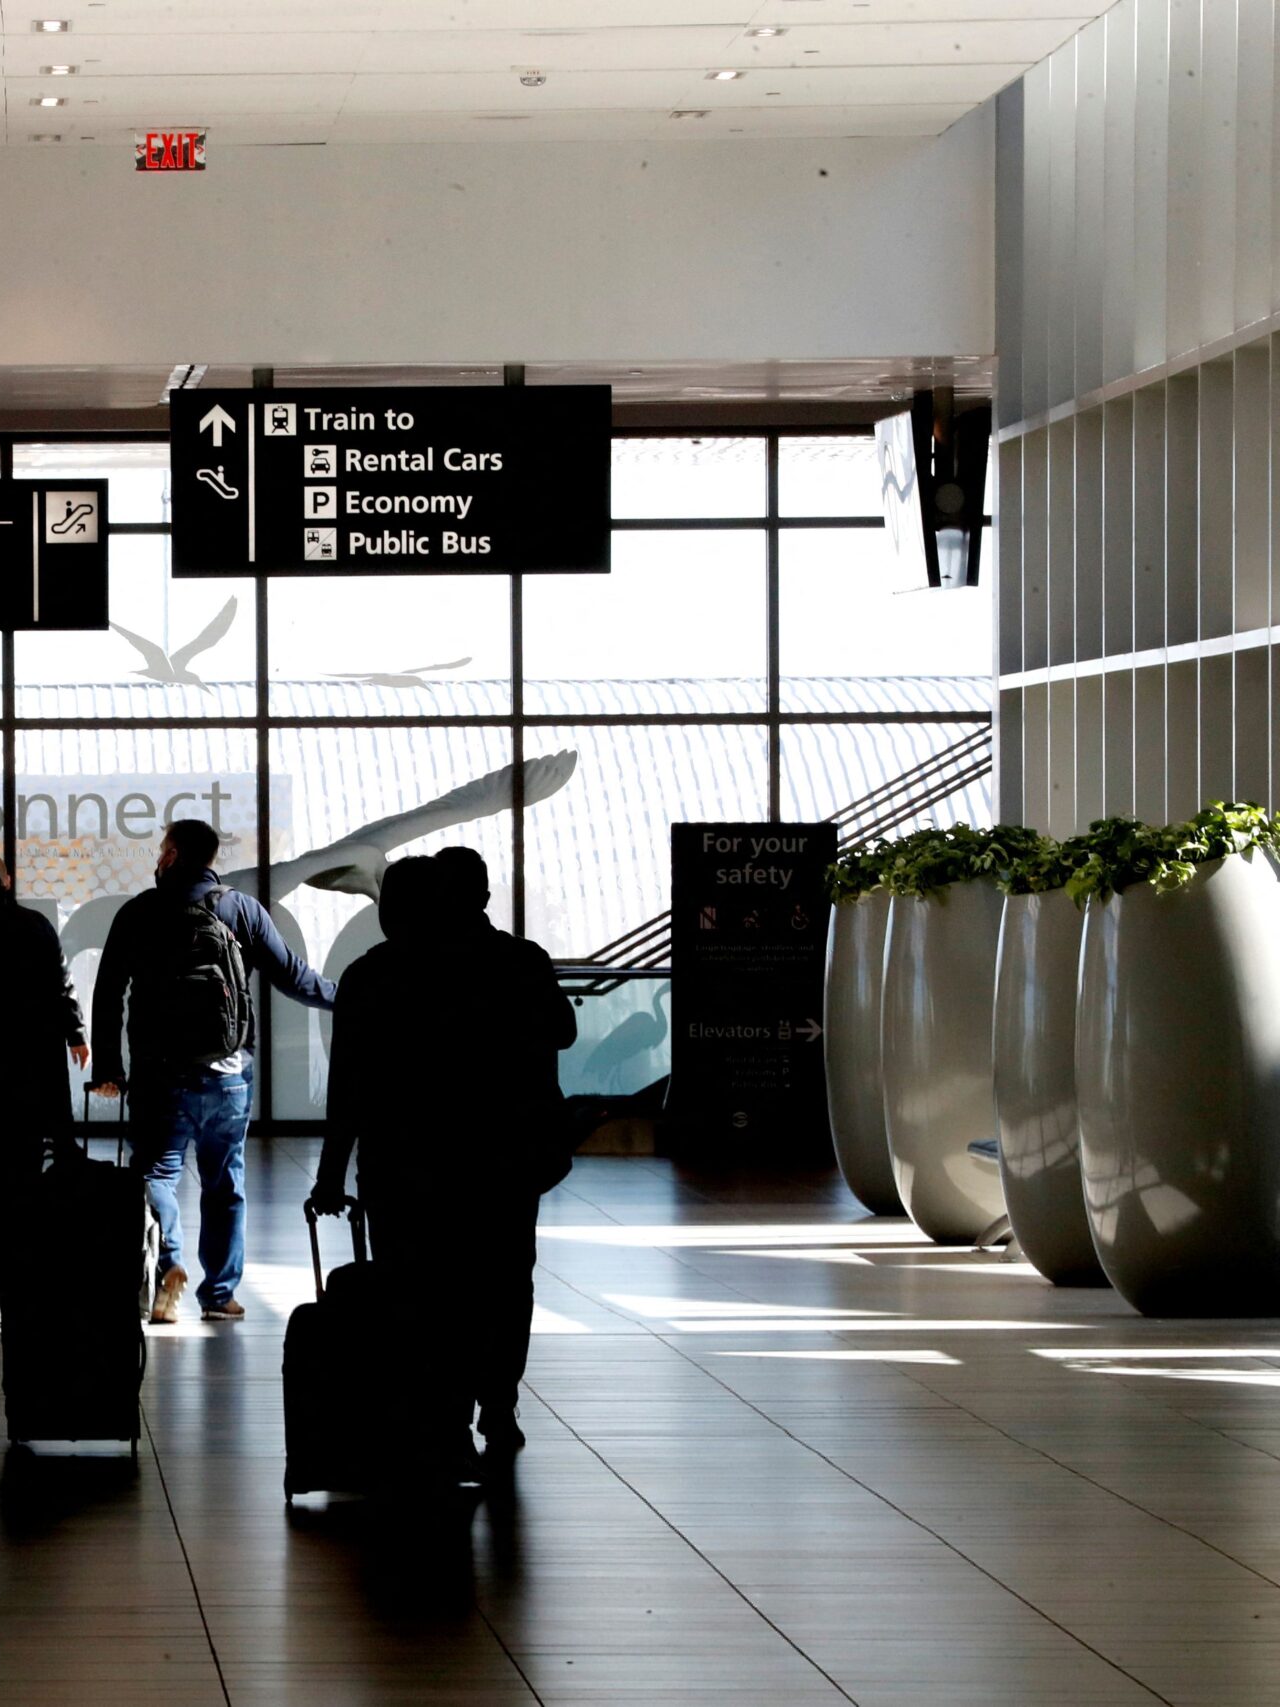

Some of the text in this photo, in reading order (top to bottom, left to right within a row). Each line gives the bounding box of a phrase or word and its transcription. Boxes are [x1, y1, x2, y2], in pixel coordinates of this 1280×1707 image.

[146, 133, 199, 168] EXIT
[304, 407, 414, 430] Train to
[346, 447, 502, 471] Rental Cars
[346, 491, 472, 519] Economy
[350, 530, 490, 554] Public Bus
[704, 833, 807, 858] For your
[717, 863, 792, 889] safety
[690, 1024, 770, 1037] Elevators
